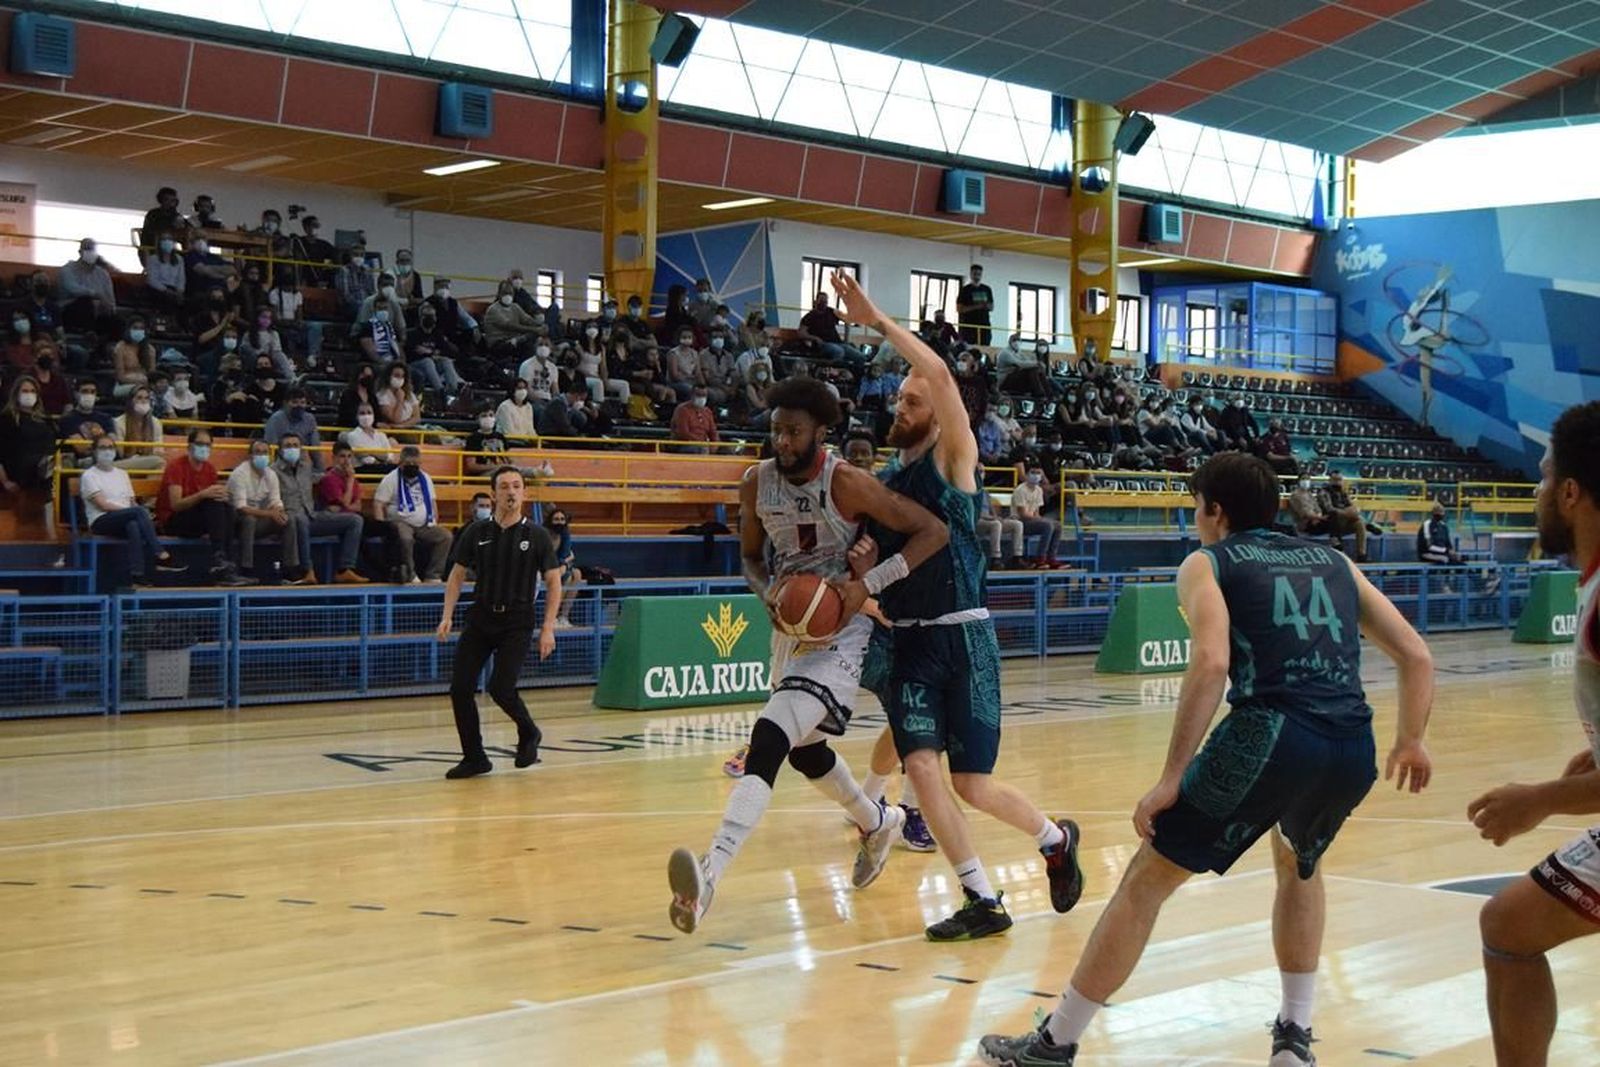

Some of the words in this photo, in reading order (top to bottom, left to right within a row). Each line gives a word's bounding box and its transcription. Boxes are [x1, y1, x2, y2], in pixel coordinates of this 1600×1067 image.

[795, 497, 812, 512] 22
[1273, 576, 1343, 643] 44
[1141, 639, 1184, 667] CAJA
[644, 664, 710, 698] CAJA
[902, 682, 928, 708] 42
